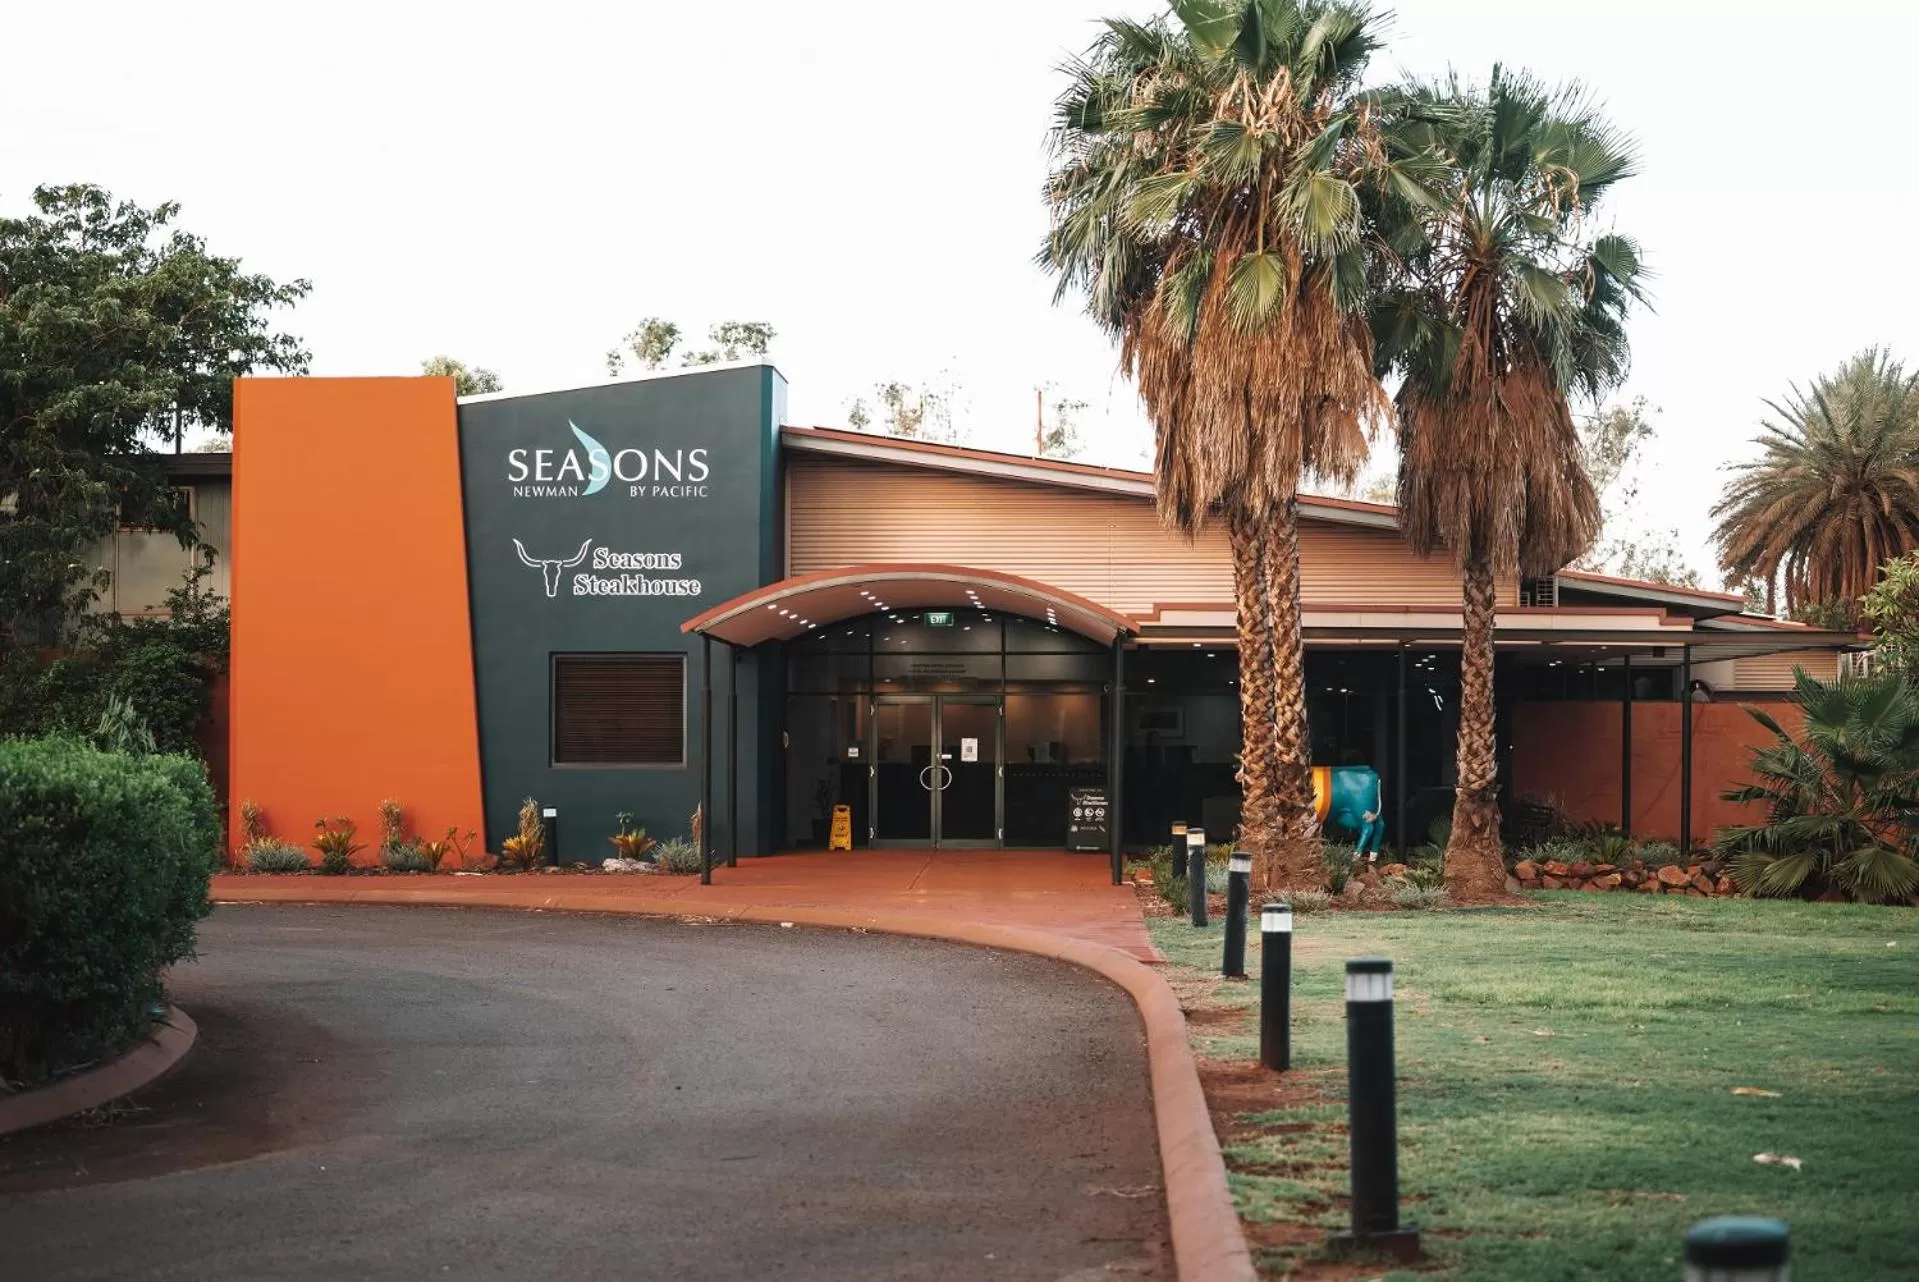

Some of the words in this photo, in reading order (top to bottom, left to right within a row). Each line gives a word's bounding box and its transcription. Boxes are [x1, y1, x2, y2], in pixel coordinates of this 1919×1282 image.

[508, 448, 710, 482] SEASONS
[513, 486, 579, 497] NEWMAN
[630, 486, 645, 497] BY
[652, 486, 709, 497] PACIFIC
[593, 547, 682, 569] Seasons
[573, 573, 701, 596] Steakhouse
